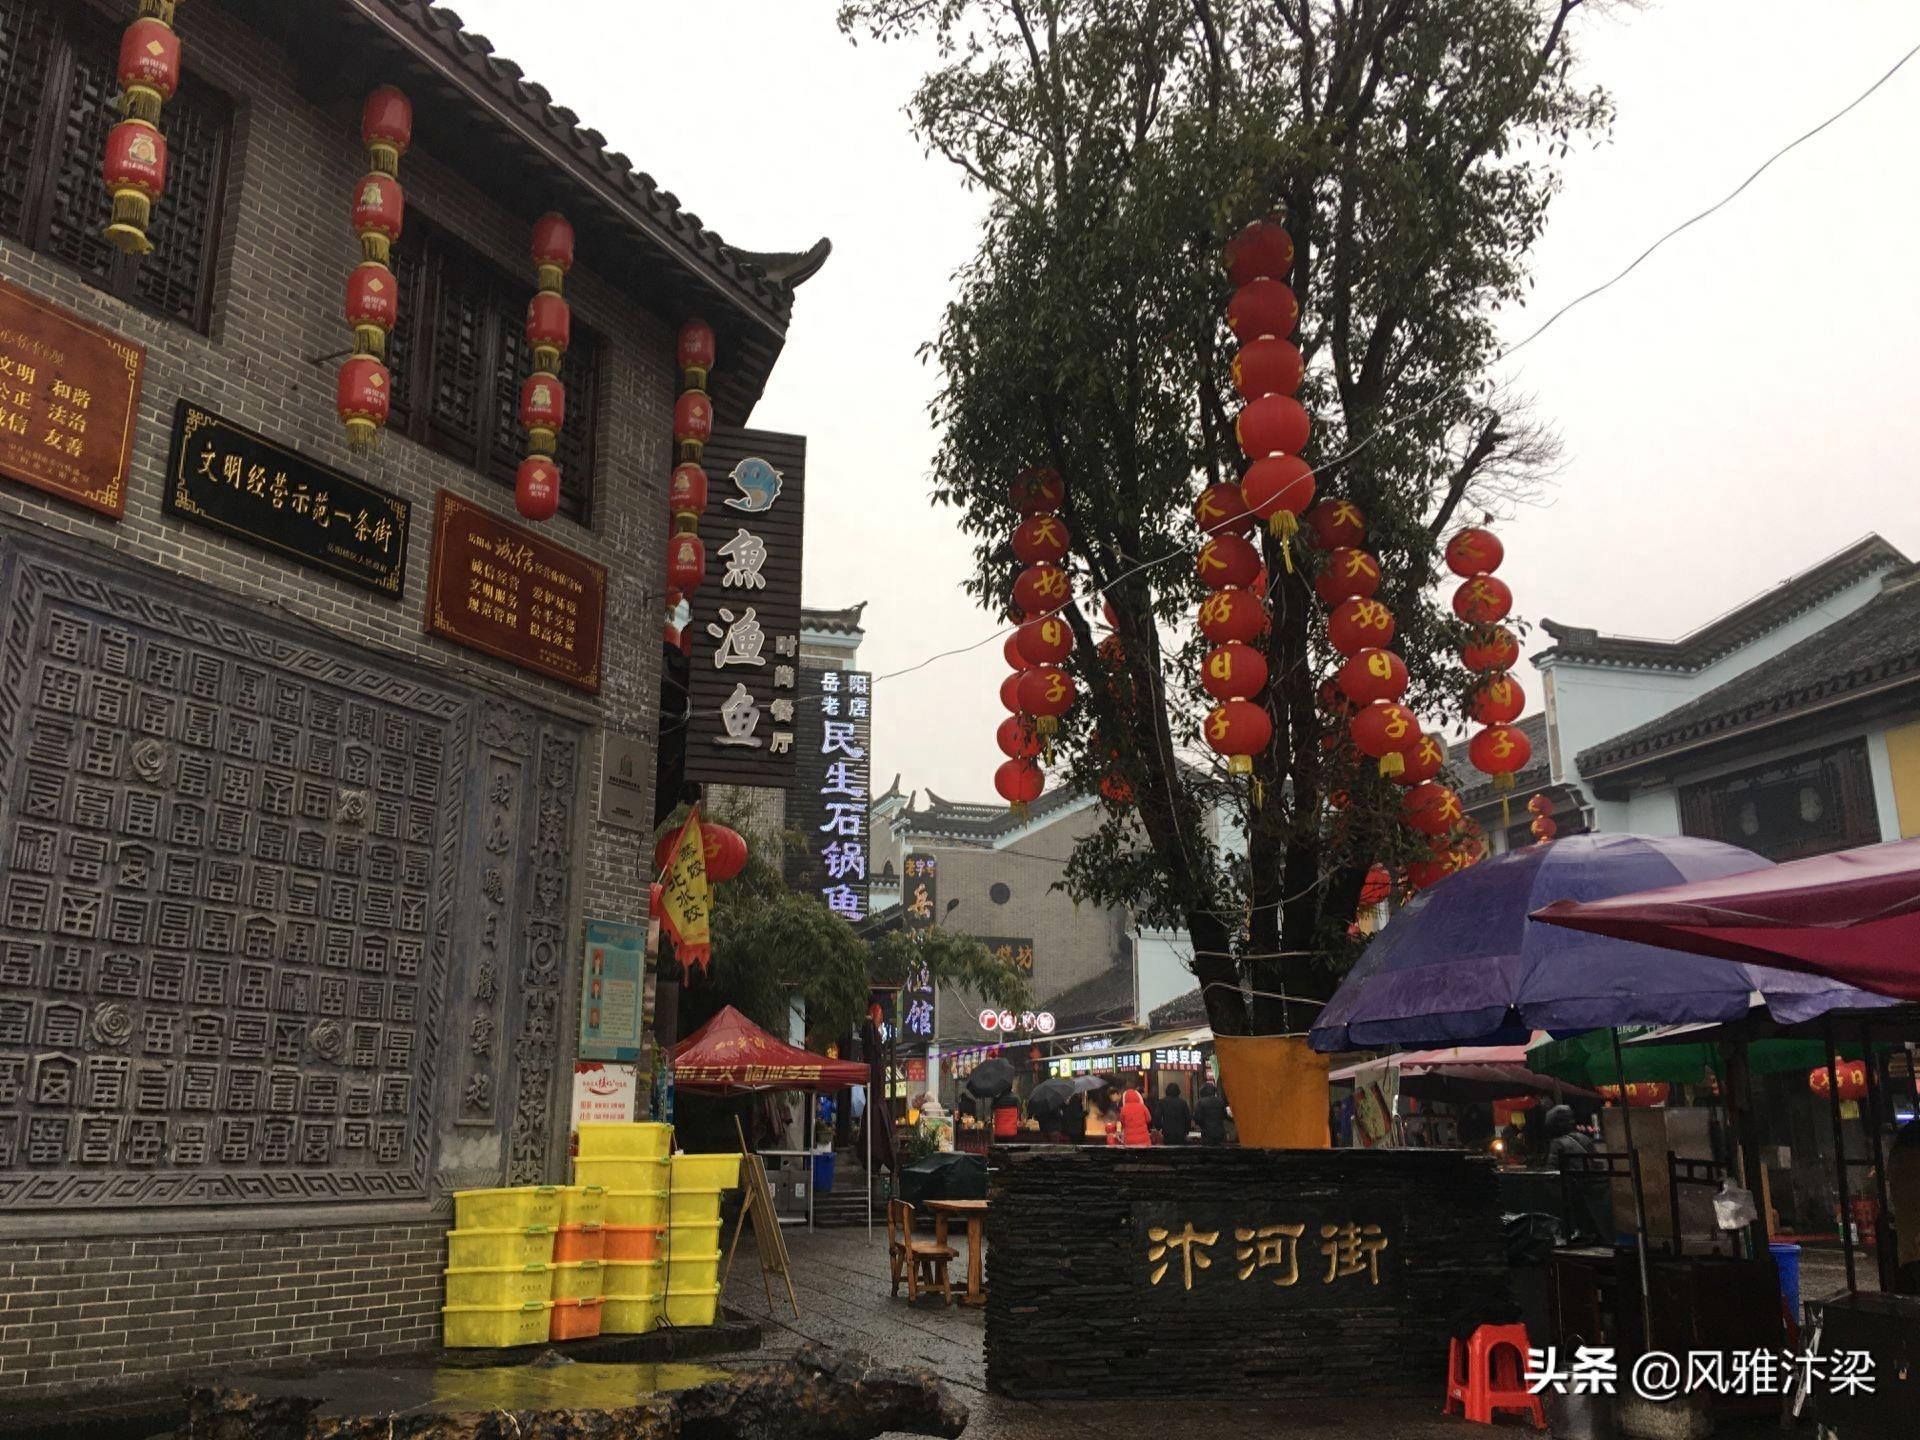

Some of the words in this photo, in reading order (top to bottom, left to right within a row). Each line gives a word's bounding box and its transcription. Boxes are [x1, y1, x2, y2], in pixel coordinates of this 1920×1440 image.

[0, 355, 37, 385] 文明
[52, 378, 92, 409] 和谐
[48, 403, 87, 433] 法治
[44, 428, 84, 458] 友善
[198, 441, 393, 553] 文明经营示范一条街
[1333, 501, 1408, 738] 天天好日子
[819, 720, 866, 922] 民生石锅鱼
[1155, 1049, 1202, 1065] 三鲜豆皮
[1149, 1222, 1388, 1290] 汴河街
